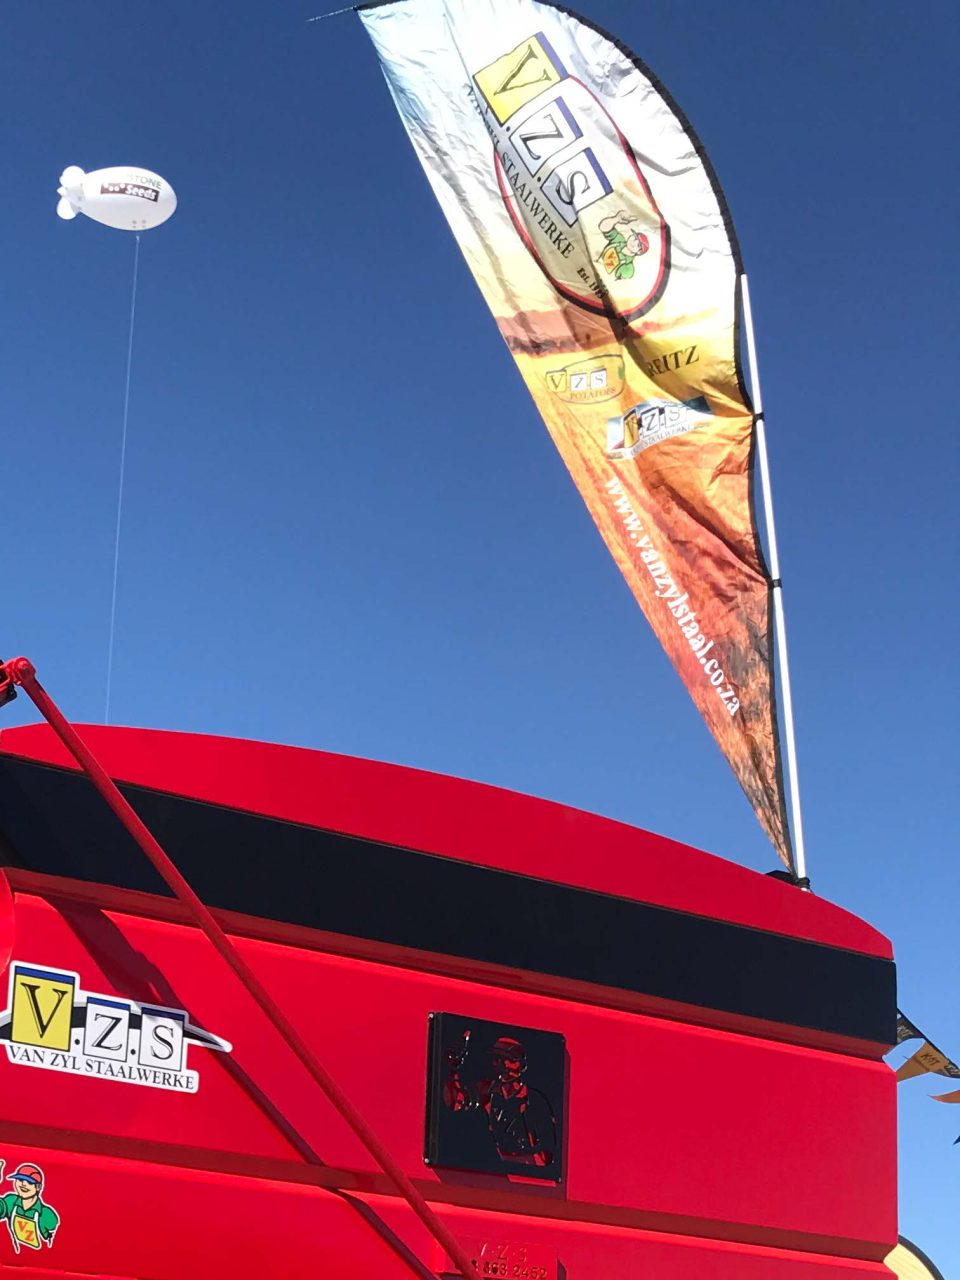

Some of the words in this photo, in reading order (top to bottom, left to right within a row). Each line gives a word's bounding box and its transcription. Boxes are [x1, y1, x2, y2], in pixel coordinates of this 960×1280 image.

[125, 184, 157, 200] Seeds
[501, 151, 576, 259] STAALWERKE
[647, 344, 700, 379] REITZ
[605, 476, 741, 716] www.vanzylstaal.co.za
[8, 1044, 46, 1064] VAN
[50, 1052, 81, 1071] ZYL
[85, 1059, 195, 1090] STAALWERKE
[513, 1263, 547, 1280] 2452
